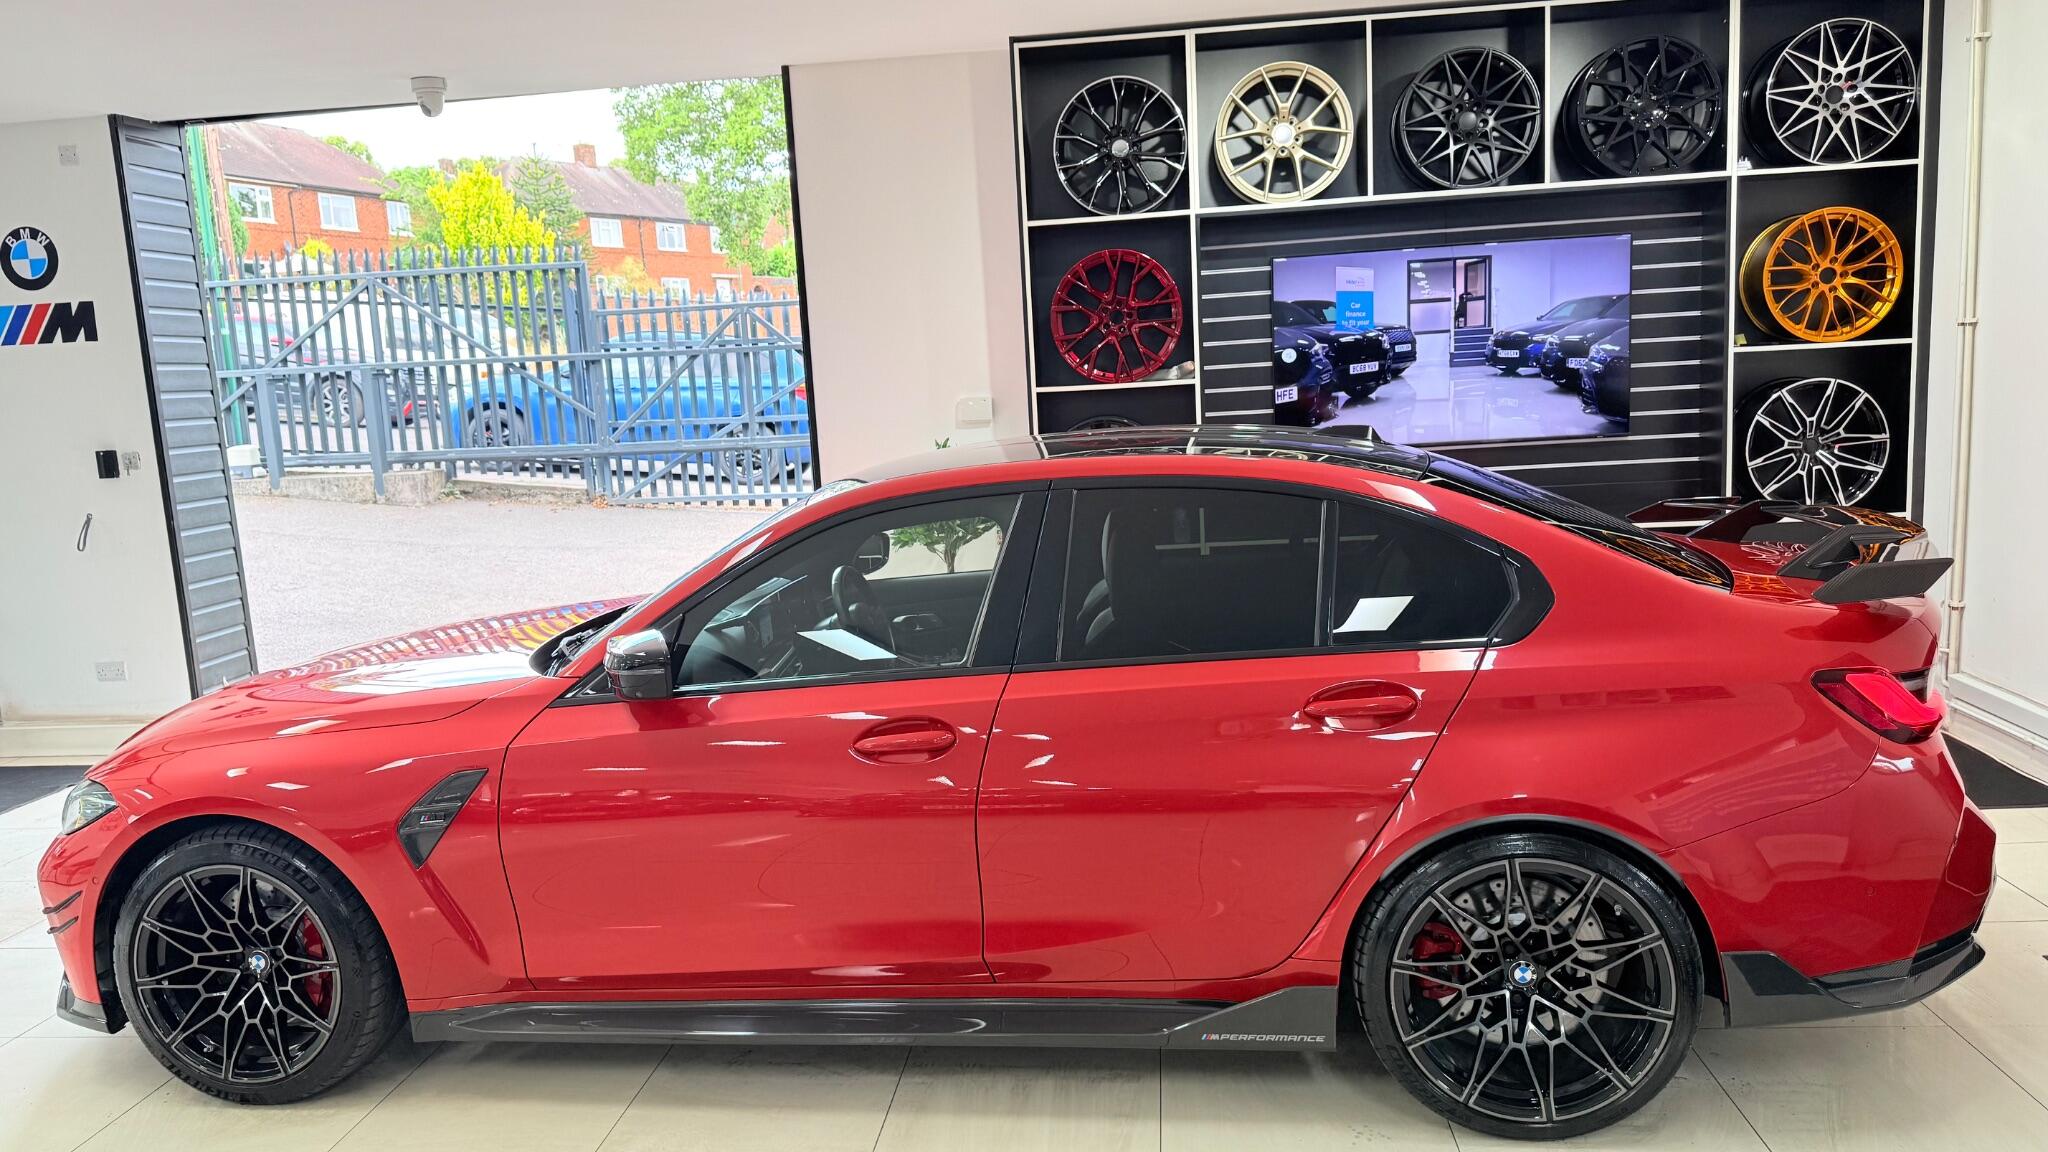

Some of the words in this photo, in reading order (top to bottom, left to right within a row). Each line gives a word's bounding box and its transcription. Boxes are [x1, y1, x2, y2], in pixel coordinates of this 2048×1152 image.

[5, 228, 50, 248] BMW
[1276, 389, 1294, 402] HFE
[229, 843, 321, 894] MICHELIN
